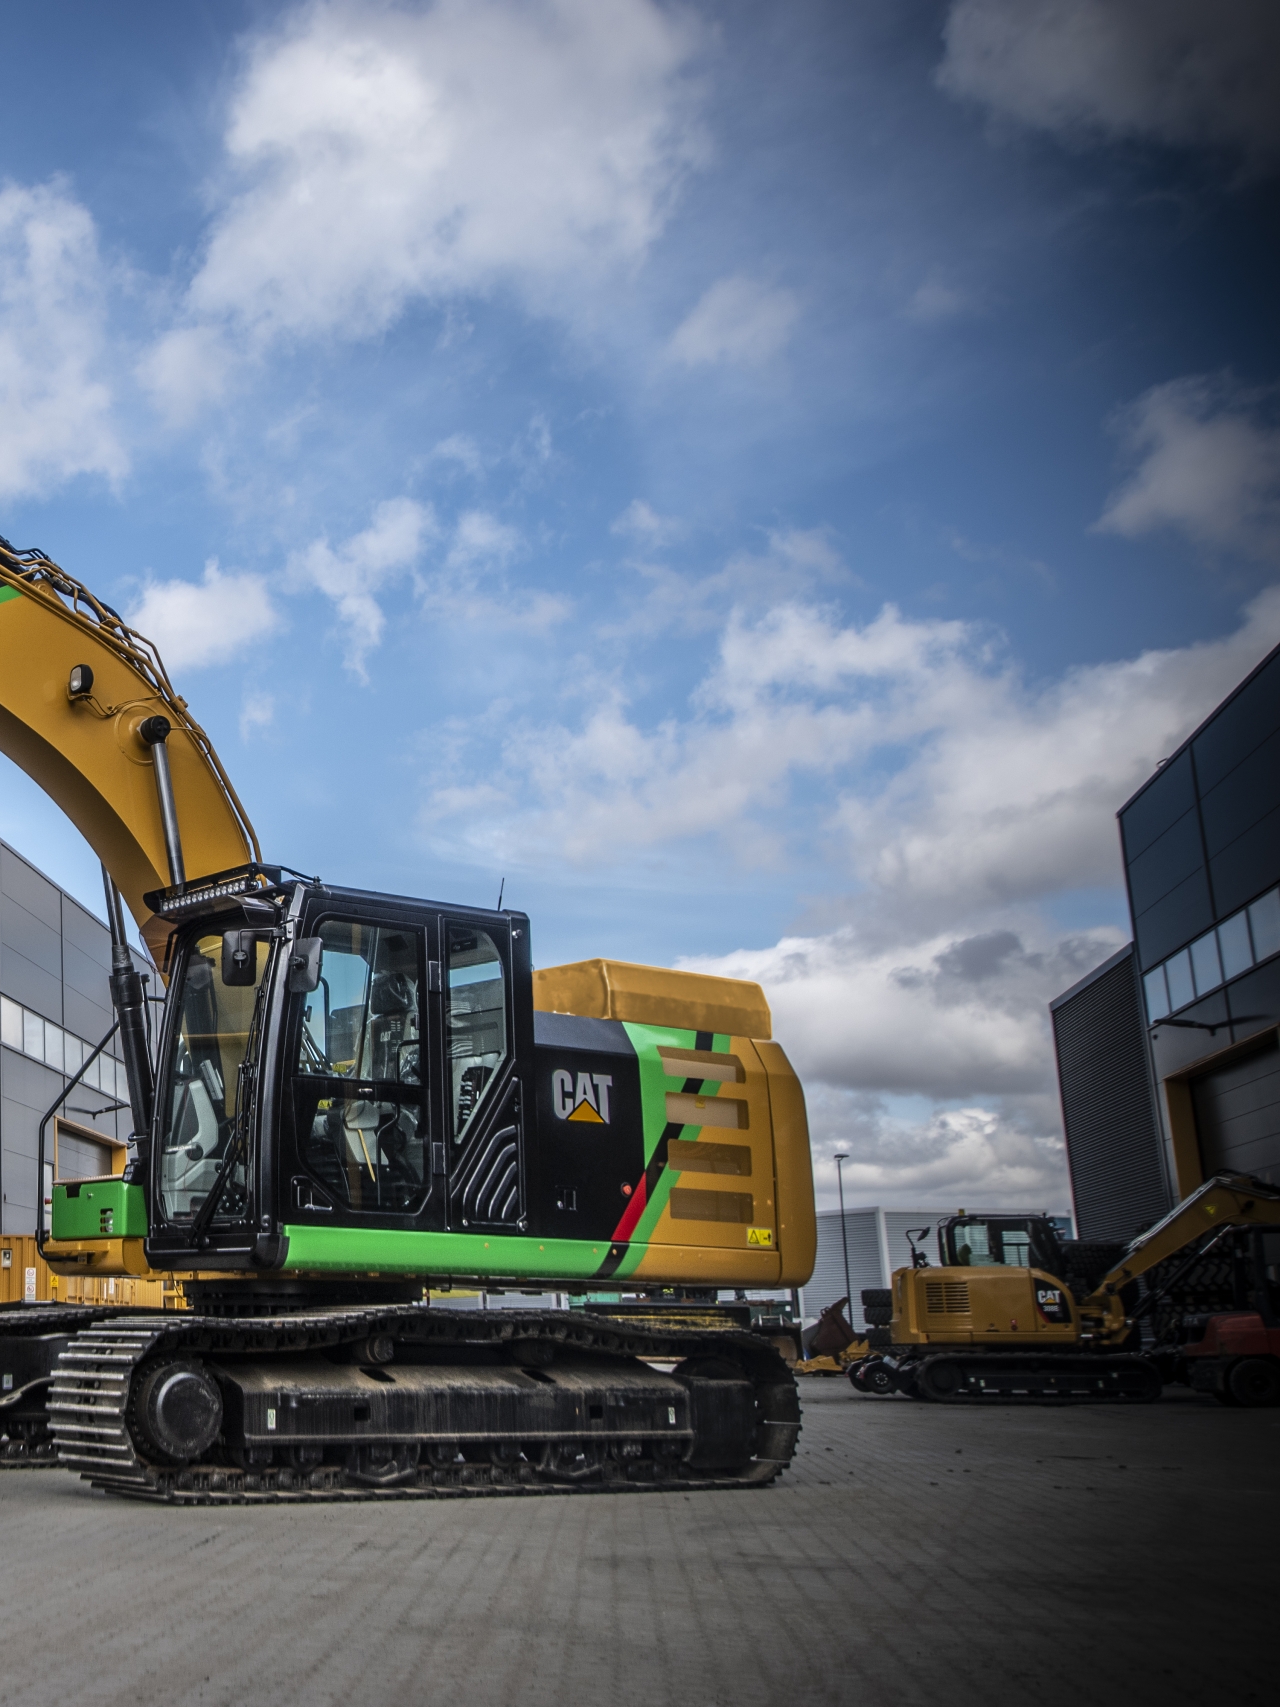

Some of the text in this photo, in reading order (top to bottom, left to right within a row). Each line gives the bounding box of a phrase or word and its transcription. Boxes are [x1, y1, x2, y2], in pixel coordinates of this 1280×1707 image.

[380, 1031, 391, 1042] CAT
[552, 1069, 613, 1124] CAT
[1037, 1290, 1060, 1303] CAT
